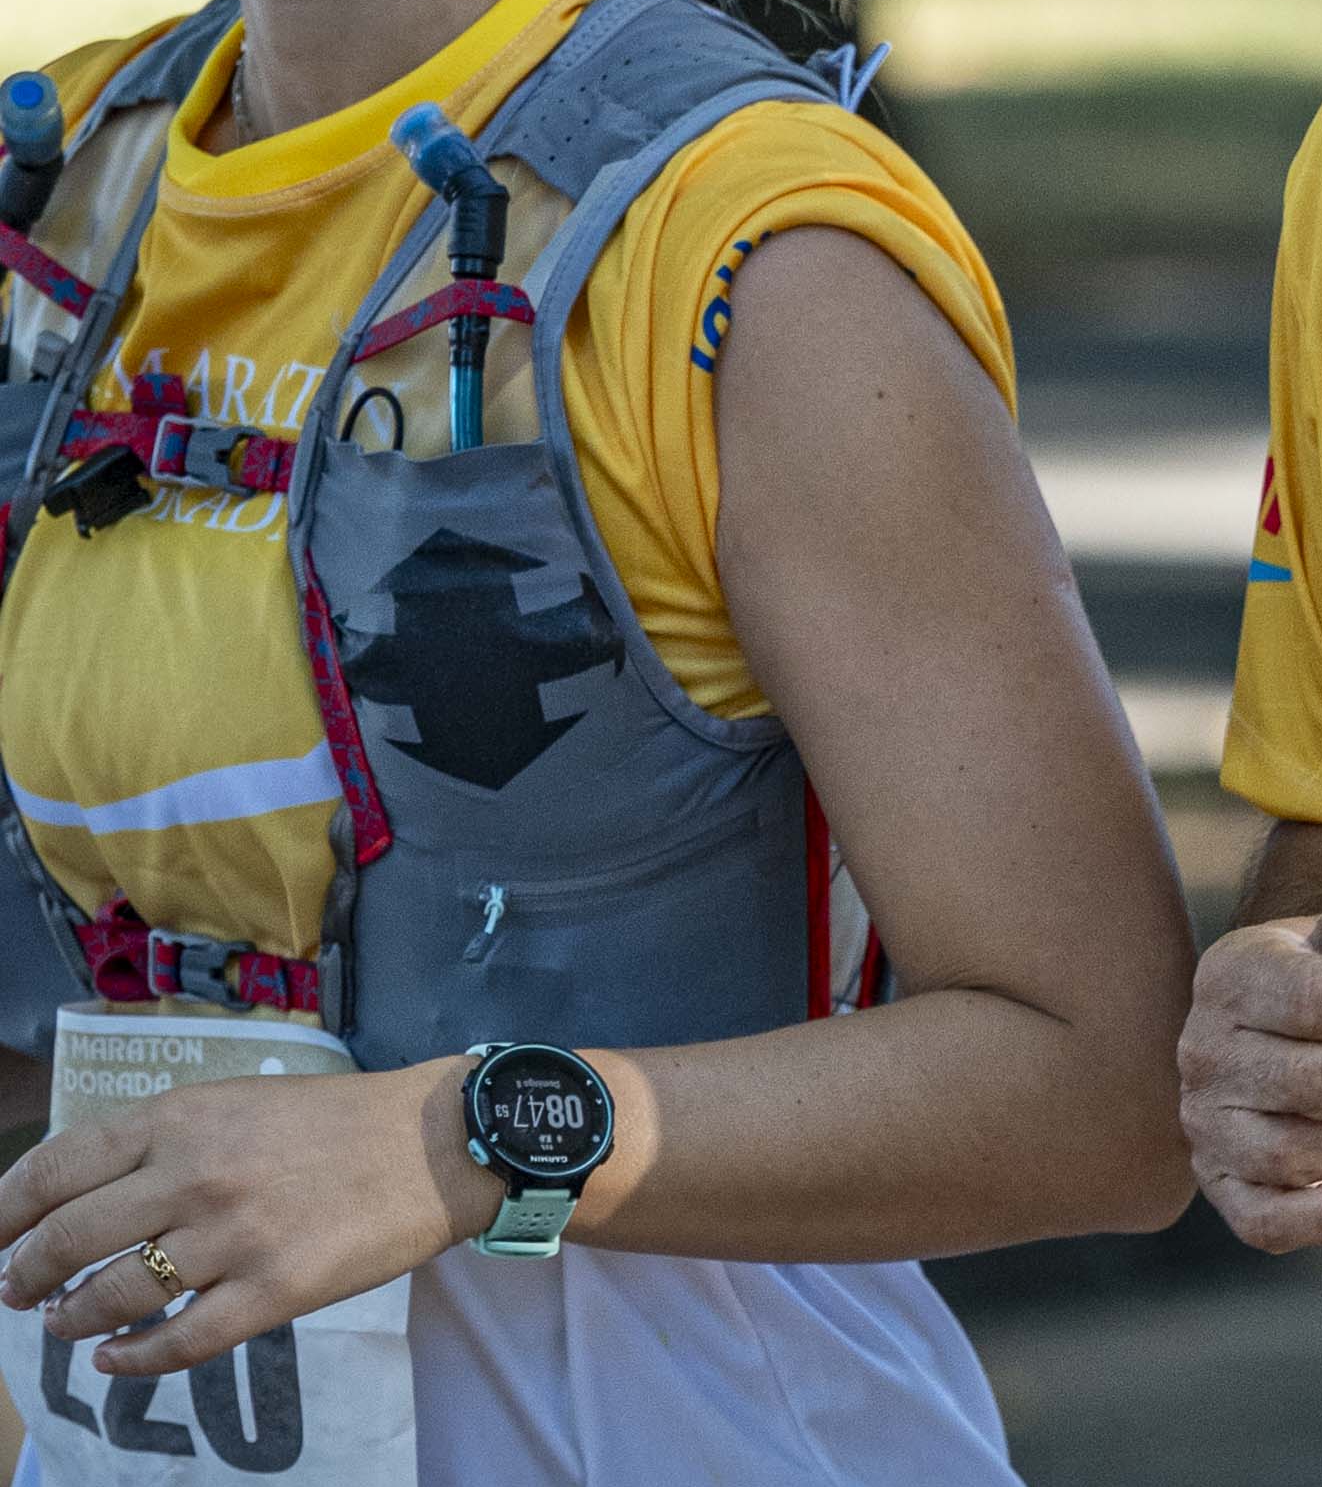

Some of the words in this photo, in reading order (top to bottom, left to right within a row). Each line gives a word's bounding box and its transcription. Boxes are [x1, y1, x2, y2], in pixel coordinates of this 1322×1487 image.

[71, 1037, 204, 1063] MARATON
[63, 1068, 173, 1097] DORADA
[530, 1155, 568, 1163] GARMIN
